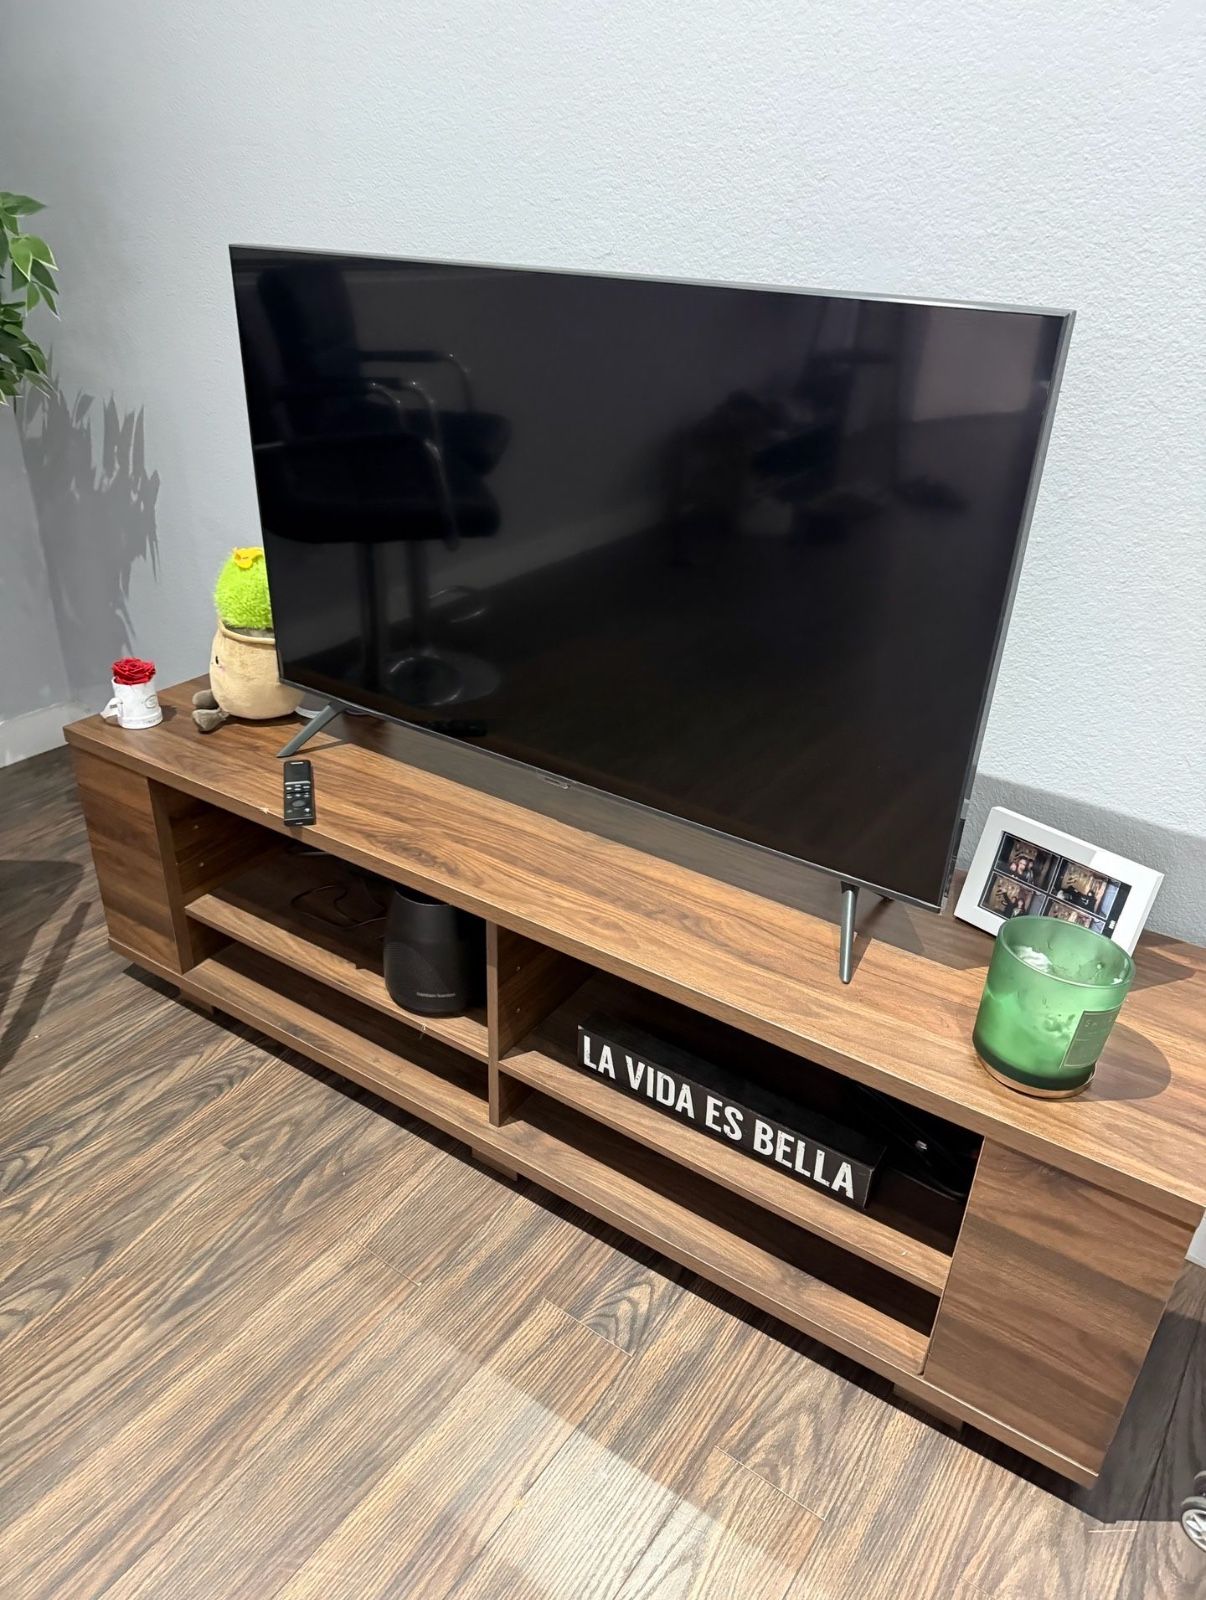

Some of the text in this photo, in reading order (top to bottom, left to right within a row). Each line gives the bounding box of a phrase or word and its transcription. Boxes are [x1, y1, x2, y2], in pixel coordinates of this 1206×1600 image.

[583, 1035, 854, 1199] LA VIDA ES BELLA
